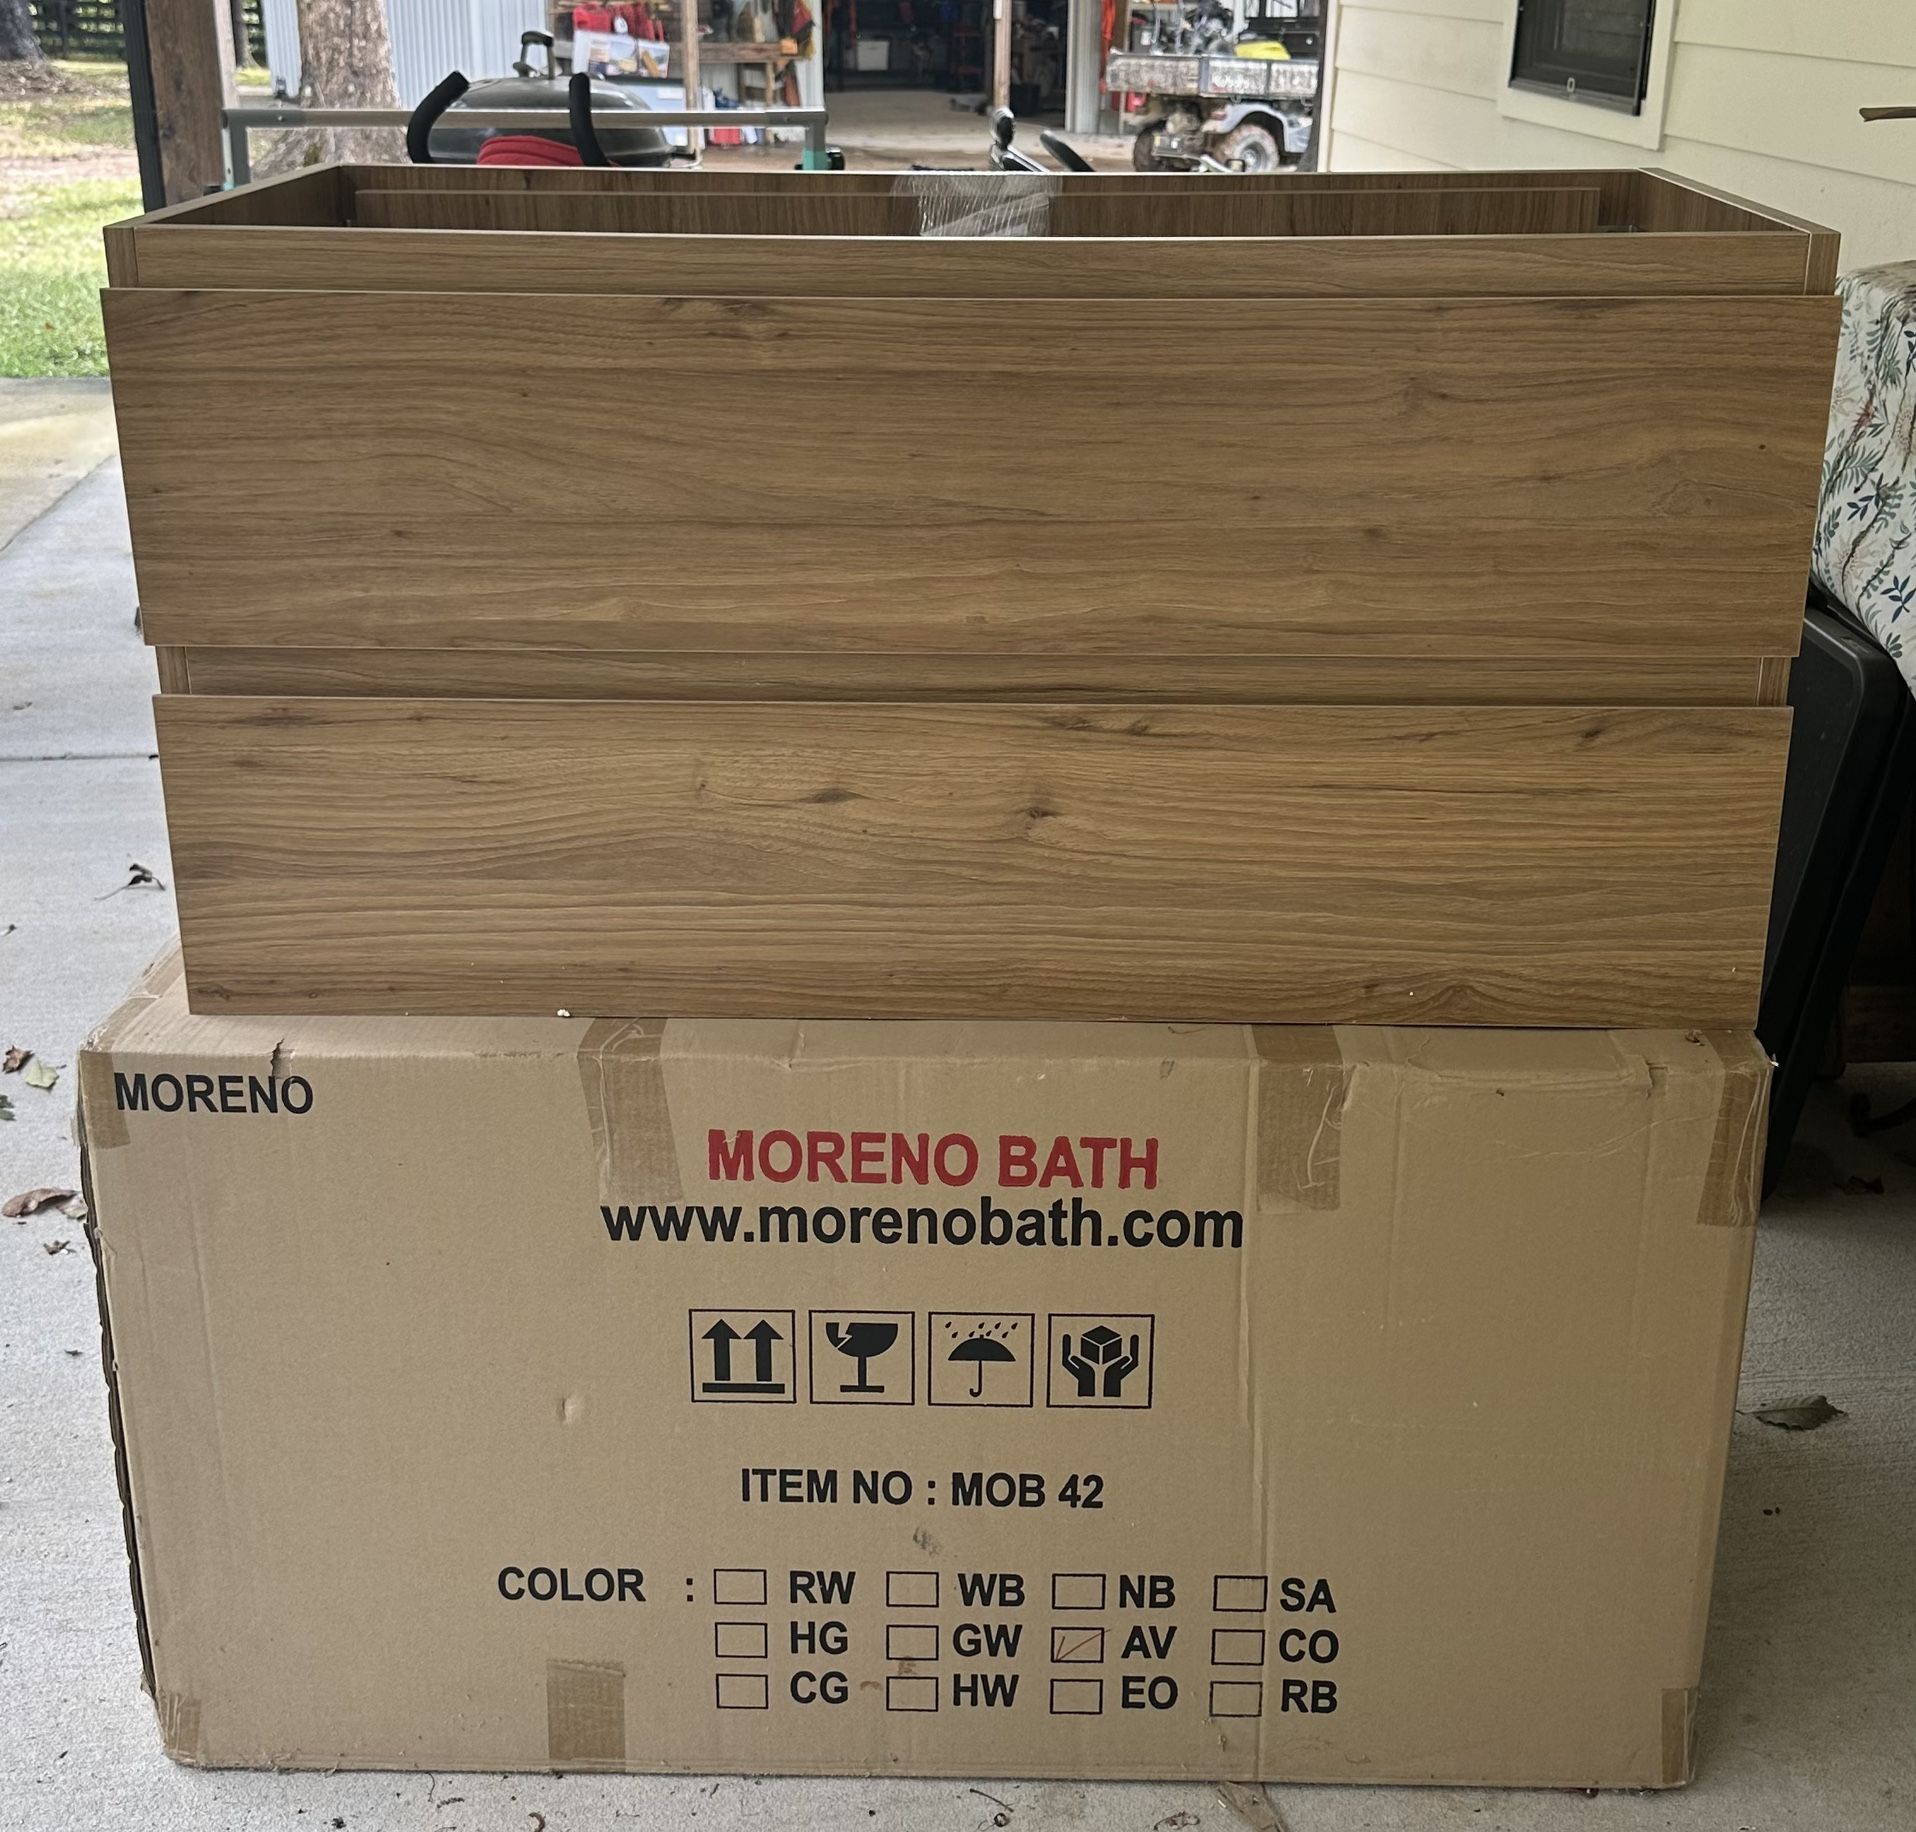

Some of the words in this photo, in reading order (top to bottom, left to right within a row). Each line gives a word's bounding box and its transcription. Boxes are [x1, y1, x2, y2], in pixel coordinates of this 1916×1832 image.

[113, 1071, 314, 1115] MORENO
[709, 1130, 978, 1185] MORENO
[1000, 1135, 1157, 1188] BATH
[599, 1195, 1244, 1249] www.morenobath.com
[741, 1468, 836, 1504] ITEM
[852, 1469, 913, 1506] NO
[927, 1480, 936, 1506] :
[951, 1471, 1046, 1508] MOB
[1057, 1473, 1104, 1509] 42
[497, 1566, 647, 1602] COLOR
[686, 1577, 694, 1602] :
[789, 1570, 857, 1605] RW
[957, 1572, 1026, 1607] WB
[1118, 1574, 1176, 1609] NB
[1279, 1577, 1337, 1614] SA
[790, 1620, 849, 1655] HG
[952, 1623, 1023, 1658] GW
[1120, 1624, 1178, 1660] AV
[1278, 1627, 1340, 1664] CO
[790, 1670, 849, 1705] CG
[952, 1673, 1020, 1708] HW
[1121, 1675, 1179, 1710] EO
[1280, 1678, 1338, 1715] RB
